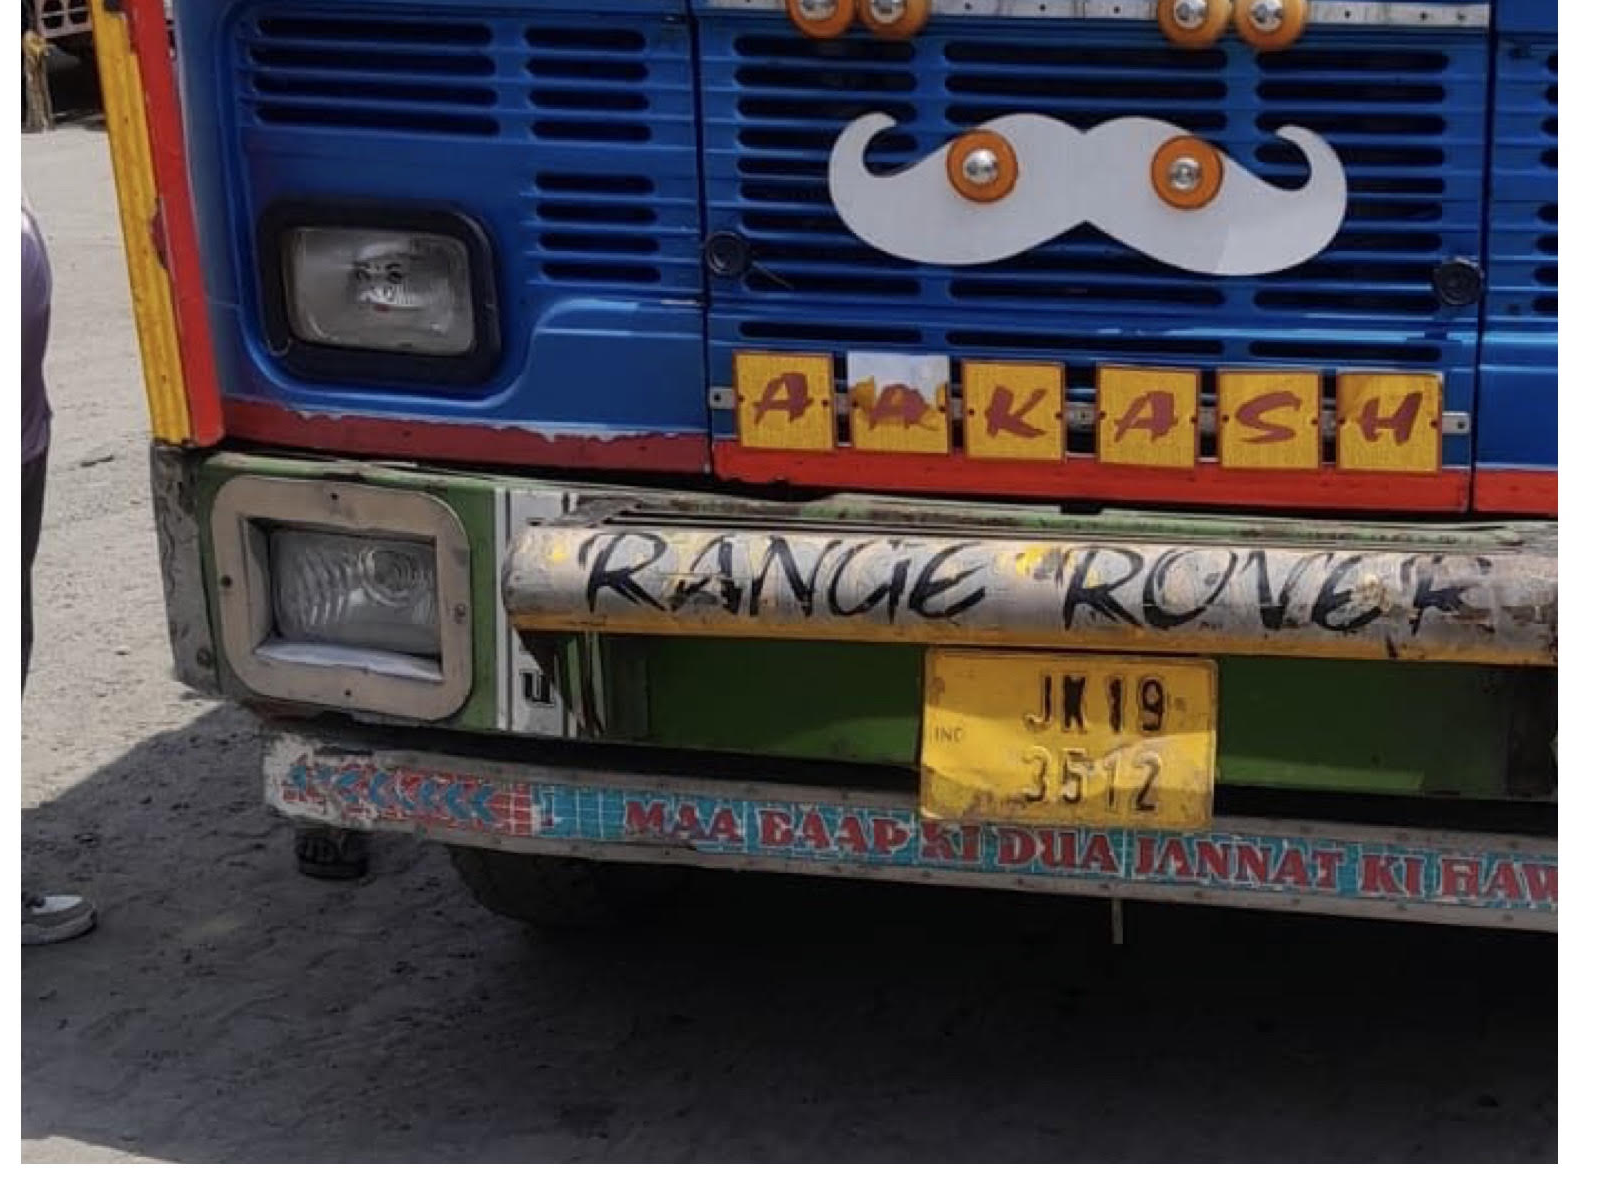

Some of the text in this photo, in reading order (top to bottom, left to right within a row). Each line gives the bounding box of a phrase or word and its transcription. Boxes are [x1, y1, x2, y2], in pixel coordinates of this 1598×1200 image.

[578, 531, 987, 625] RANGE
[1020, 746, 1161, 812] 3512
[624, 798, 744, 843] MAA
[756, 808, 910, 855] BAAP
[919, 821, 984, 863] KI
[996, 826, 1122, 875] DUA
[1130, 834, 1347, 889] JANNAT
[1358, 852, 1426, 897] KI
